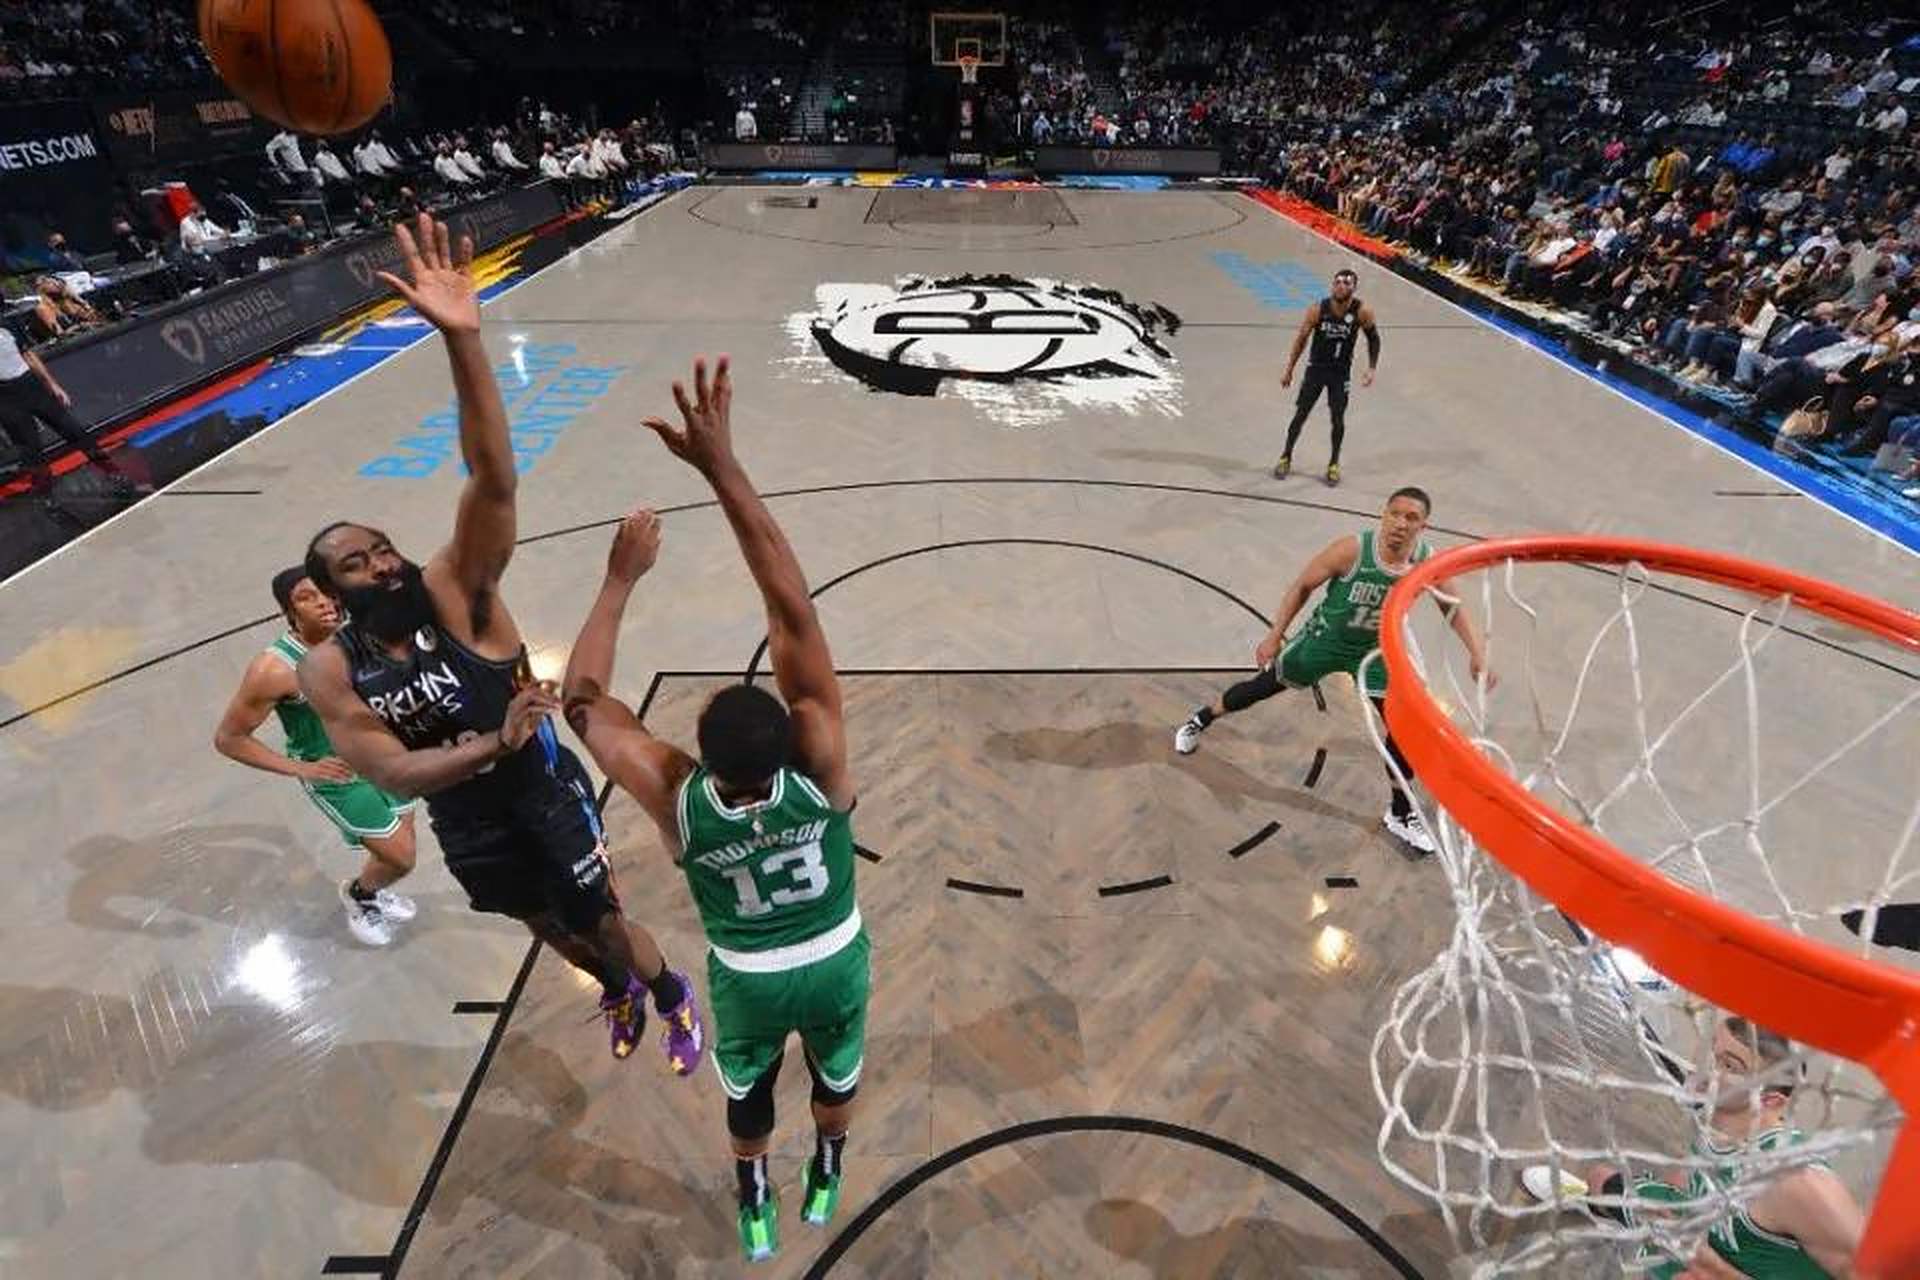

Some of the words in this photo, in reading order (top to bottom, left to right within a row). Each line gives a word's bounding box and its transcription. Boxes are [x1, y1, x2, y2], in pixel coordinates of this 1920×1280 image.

[1348, 580, 1386, 604] BOS
[693, 817, 830, 872] THOMPSON
[721, 840, 830, 918] 13
